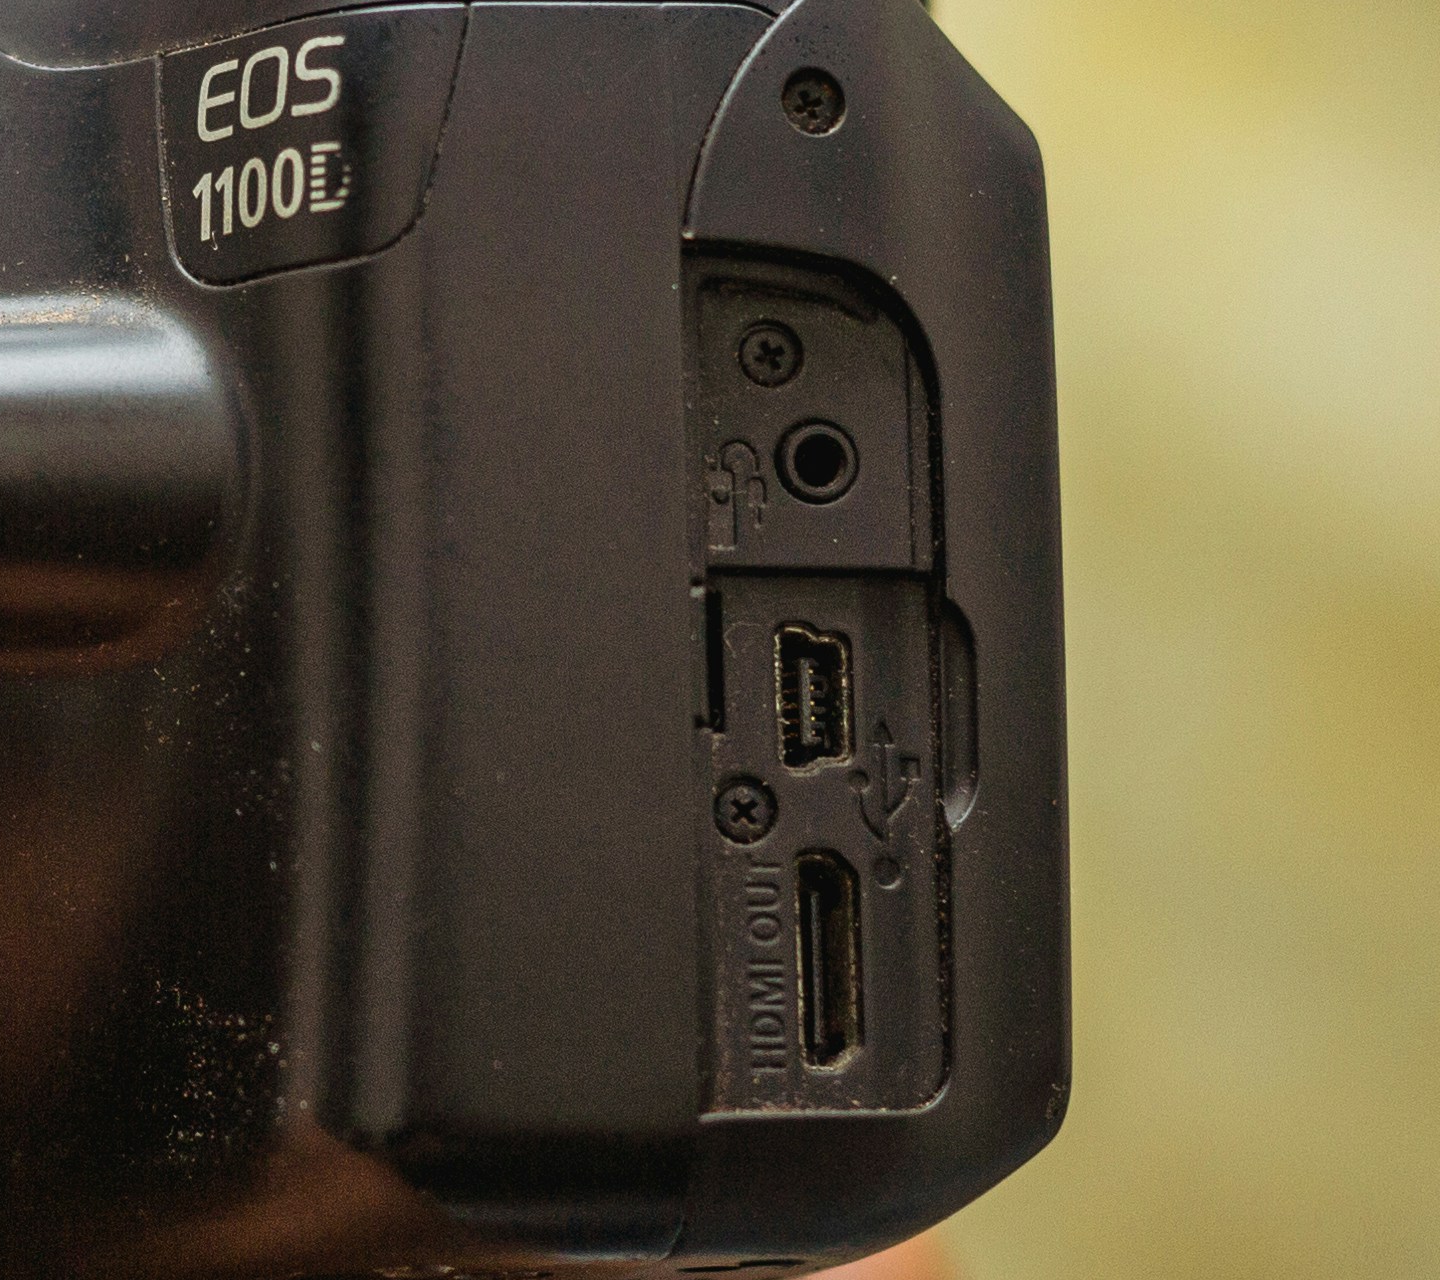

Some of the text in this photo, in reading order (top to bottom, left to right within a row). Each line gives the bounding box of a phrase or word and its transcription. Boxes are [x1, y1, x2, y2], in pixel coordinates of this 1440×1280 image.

[196, 35, 345, 143] EOS
[191, 141, 352, 242] 1100D
[747, 956, 787, 1074] HDMI
